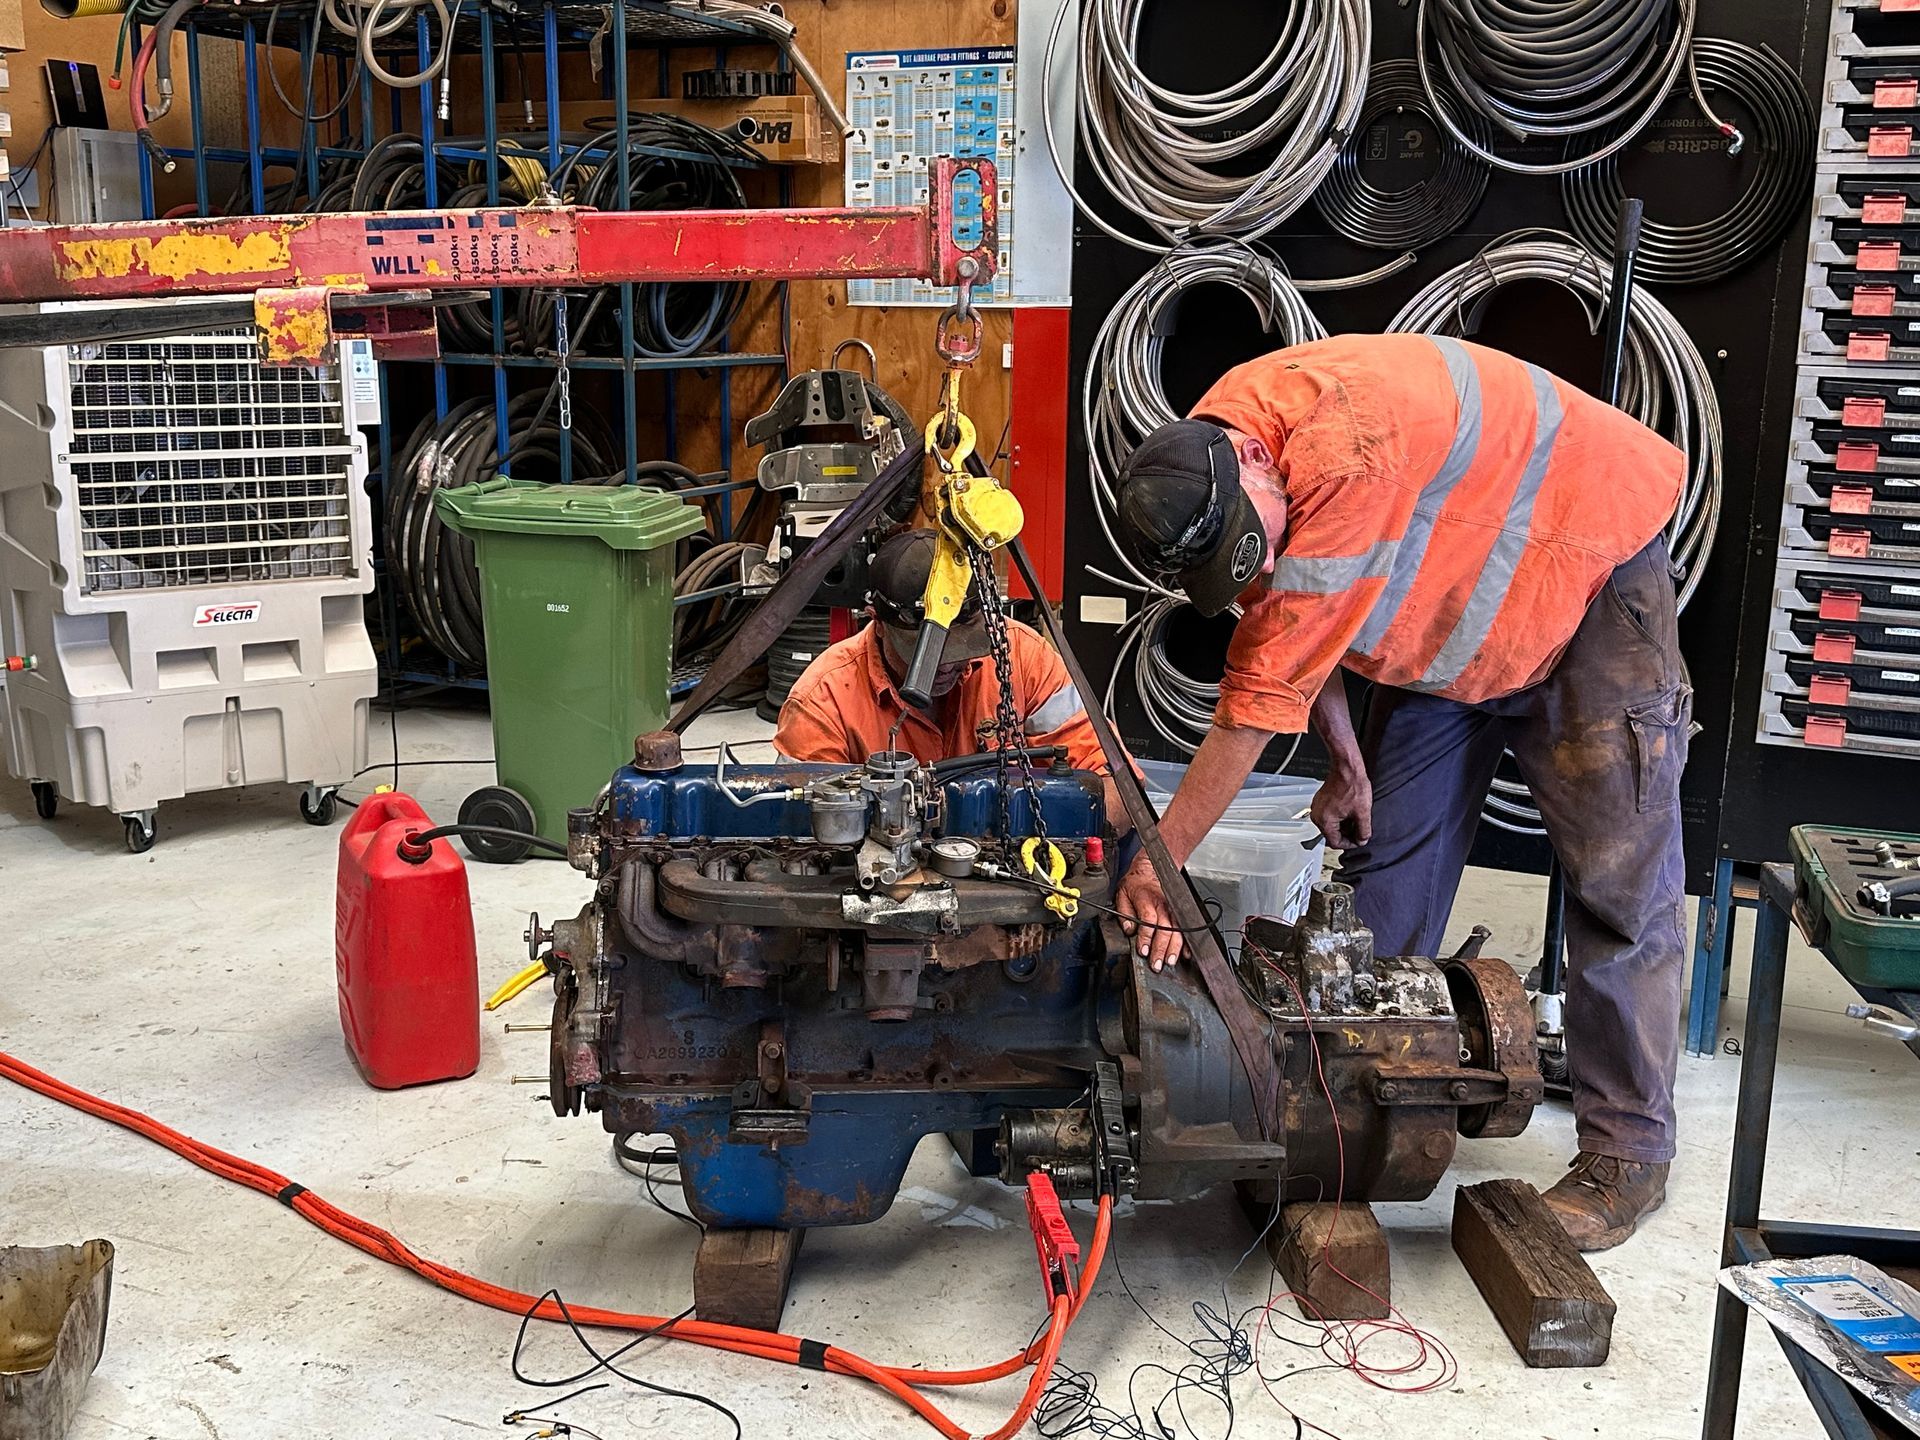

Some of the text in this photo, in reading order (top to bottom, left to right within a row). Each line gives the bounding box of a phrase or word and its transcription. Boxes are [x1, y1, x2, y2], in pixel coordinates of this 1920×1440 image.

[1667, 138, 1731, 154] pecRite
[470, 234, 481, 280] 1650kg
[546, 603, 570, 613] 001652
